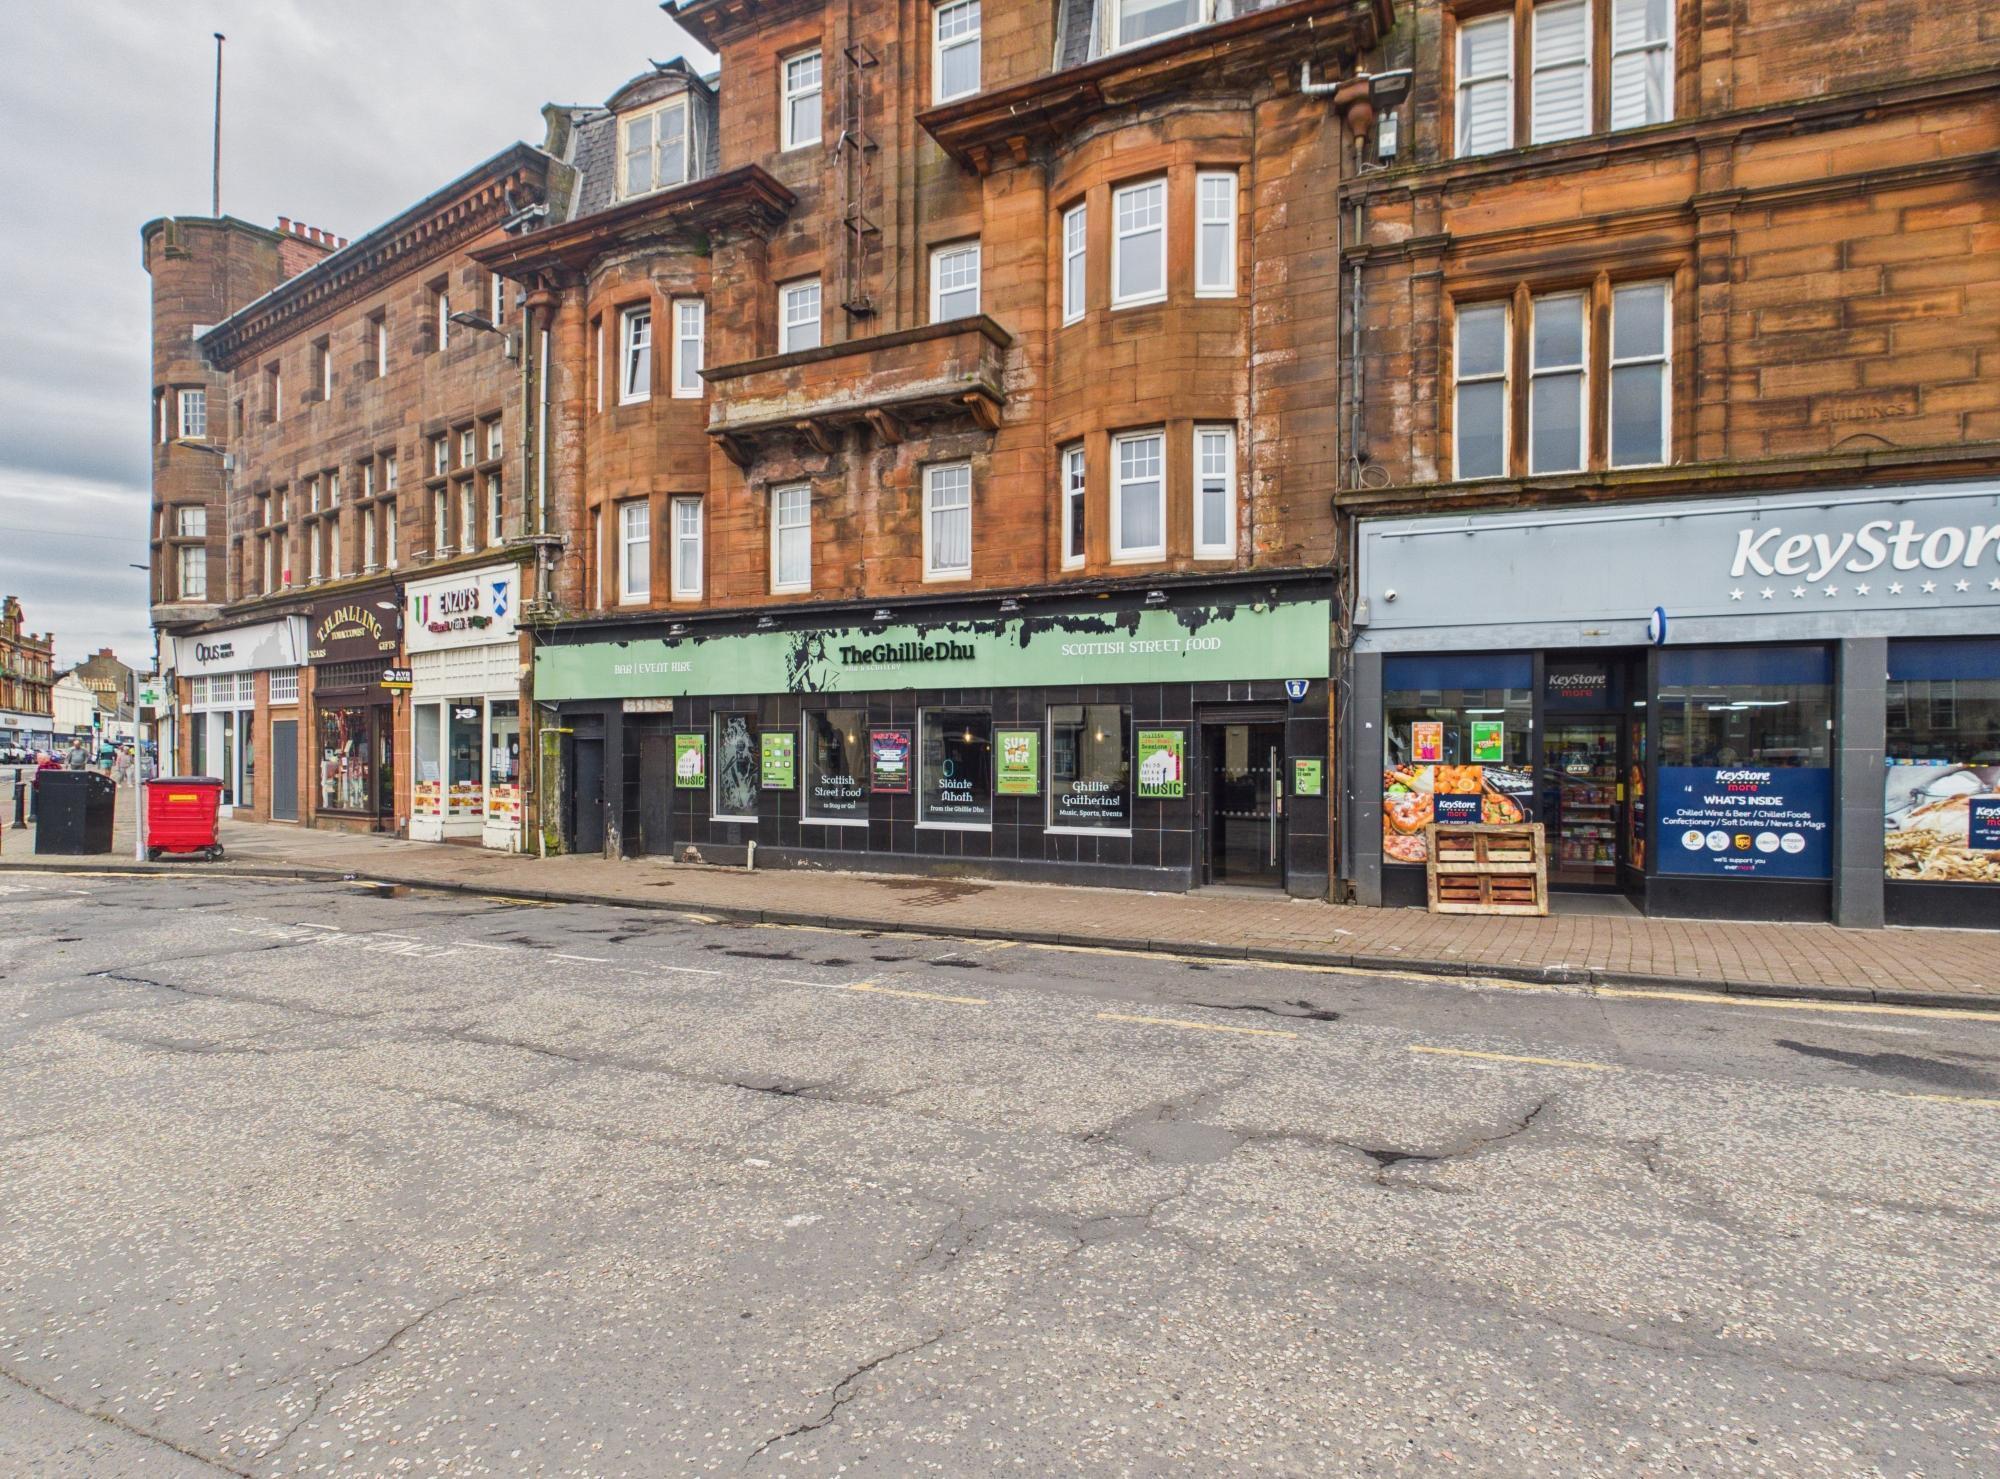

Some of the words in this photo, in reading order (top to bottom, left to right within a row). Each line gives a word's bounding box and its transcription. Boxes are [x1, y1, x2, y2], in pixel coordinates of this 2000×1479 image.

[1820, 404, 1905, 422] BUILDINGS
[1730, 520, 2000, 582] KeyStor
[440, 588, 479, 615] ENZO'S
[839, 640, 976, 665] TheGhillieDhu
[1061, 641, 1124, 656] SCOTTISH
[1129, 639, 1181, 653] STREET
[1185, 637, 1221, 650] FOOD
[195, 642, 220, 667] Opus
[614, 664, 633, 675] BAR
[639, 662, 669, 673] EVENT
[671, 661, 692, 672] HIRE
[1549, 674, 1606, 686] KeyStore
[1561, 688, 1593, 697] more
[677, 775, 704, 786] MUSIC
[821, 775, 855, 785] Scottish
[1716, 770, 1770, 782] KeyStore
[814, 787, 839, 796] Street
[841, 787, 862, 797] Food
[1072, 781, 1110, 793] Ghillie
[1140, 783, 1181, 795] MUSIC
[1728, 784, 1758, 792] more
[1439, 800, 1476, 809] KeyStore
[1704, 796, 1746, 805] WHAT'S
[1748, 797, 1783, 806] INSIDE
[1079, 810, 1101, 818] Sports,
[1676, 809, 1704, 817] Chilled
[1704, 809, 1724, 817] Wine
[1758, 810, 1786, 818] Chilled
[1787, 810, 1811, 819] Foods
[1662, 817, 1716, 827] Confectionery
[1721, 818, 1738, 826] Soft
[1739, 818, 1764, 827] Drinks
[1770, 819, 1793, 828] News
[1795, 820, 1802, 828] &
[1803, 820, 1826, 829] Mags
